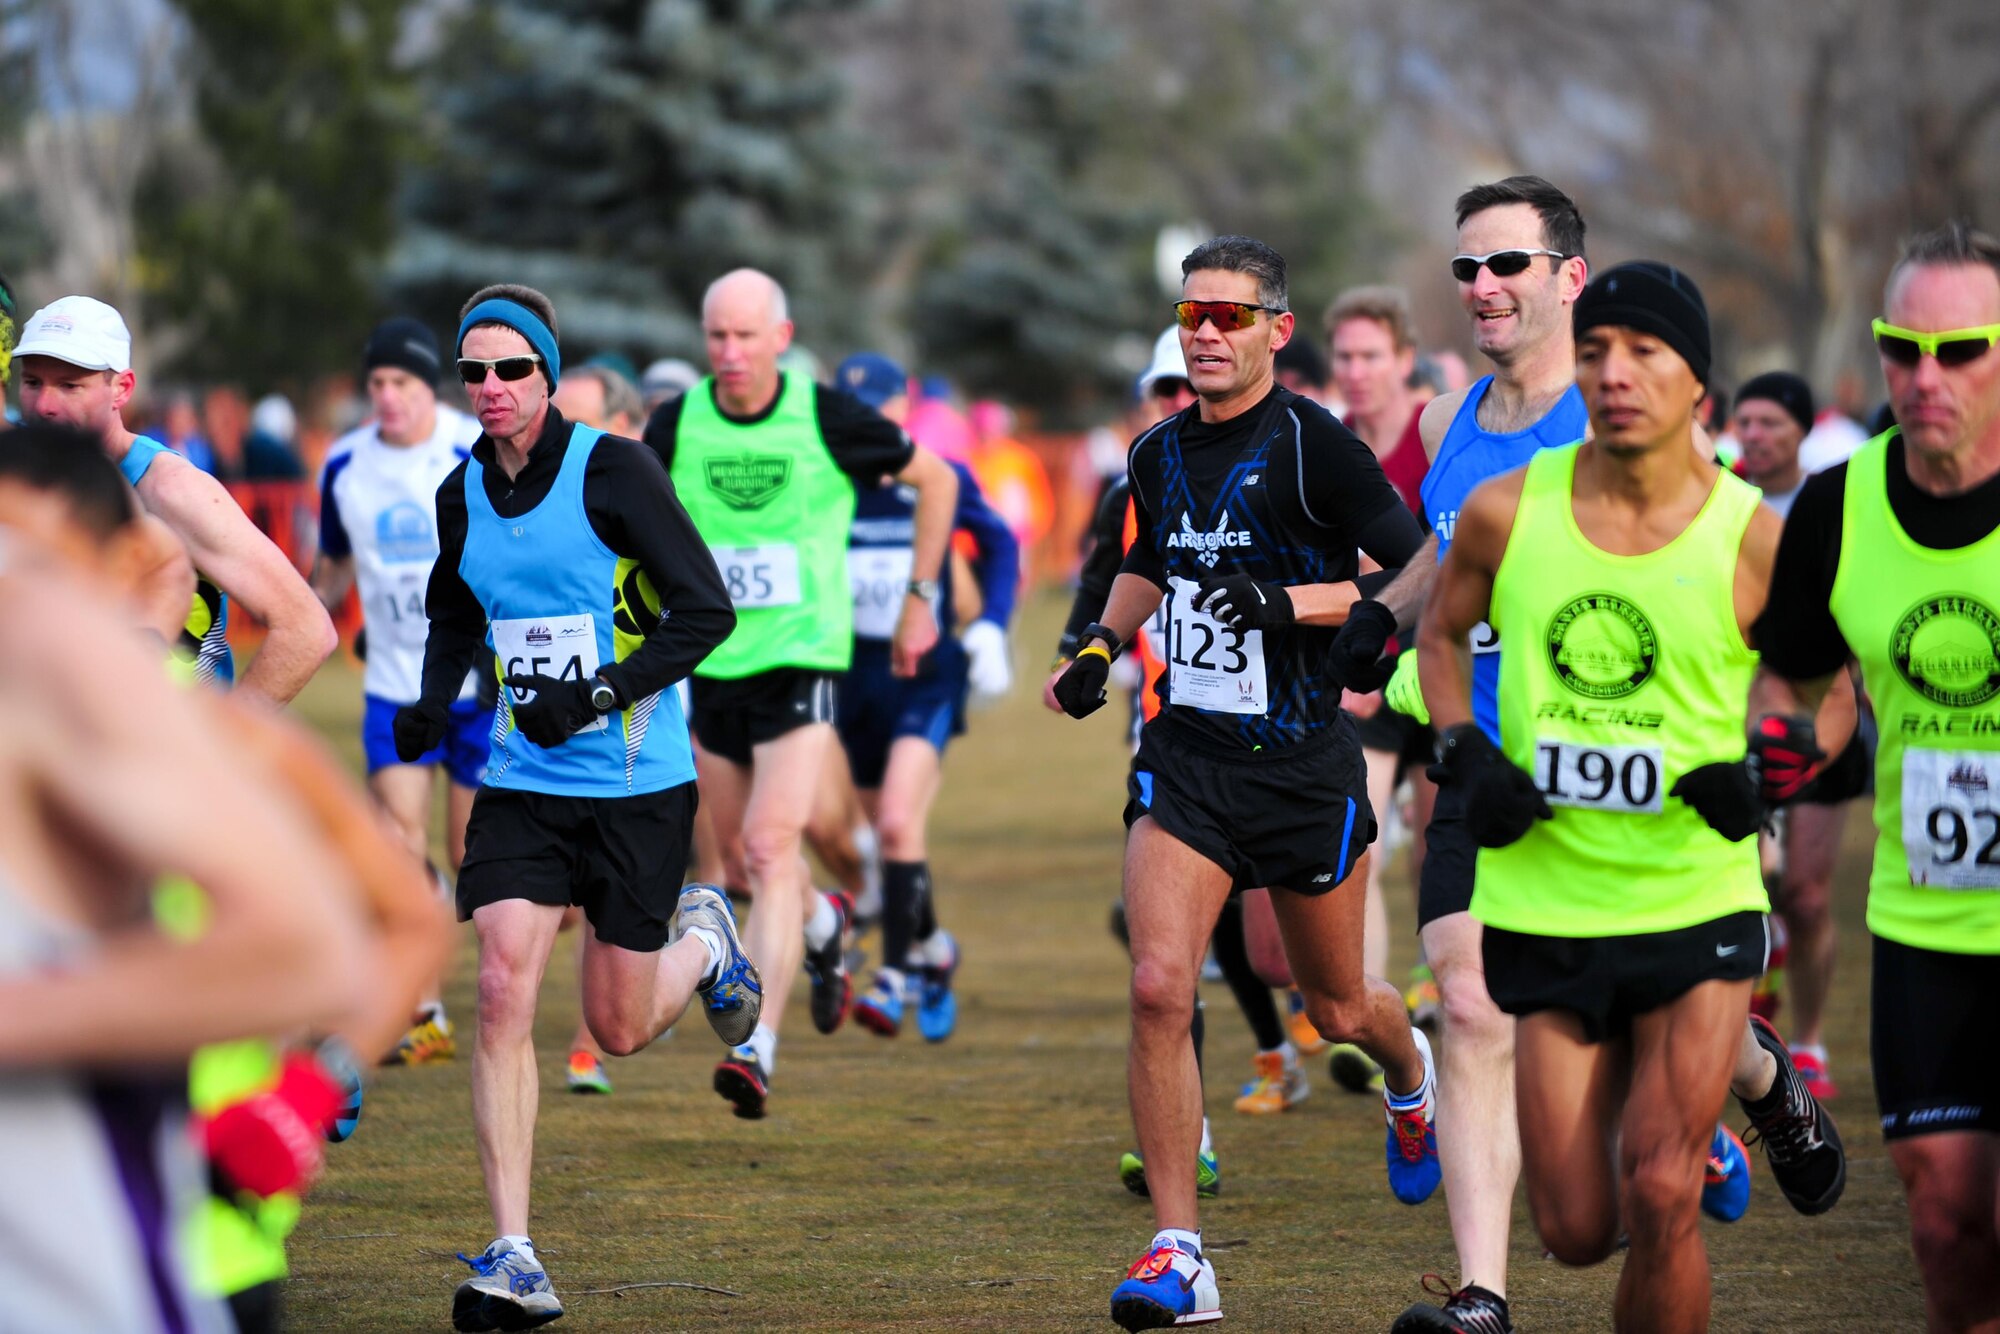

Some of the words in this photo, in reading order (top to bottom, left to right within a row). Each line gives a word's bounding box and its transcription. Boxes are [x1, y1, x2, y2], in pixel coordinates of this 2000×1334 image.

[1197, 531, 1252, 548] FORCE
[727, 564, 773, 600] 85
[1171, 618, 1248, 674] 123
[1537, 702, 1665, 729] RACING
[1540, 745, 1658, 806] 190
[1926, 806, 2000, 866] 92
